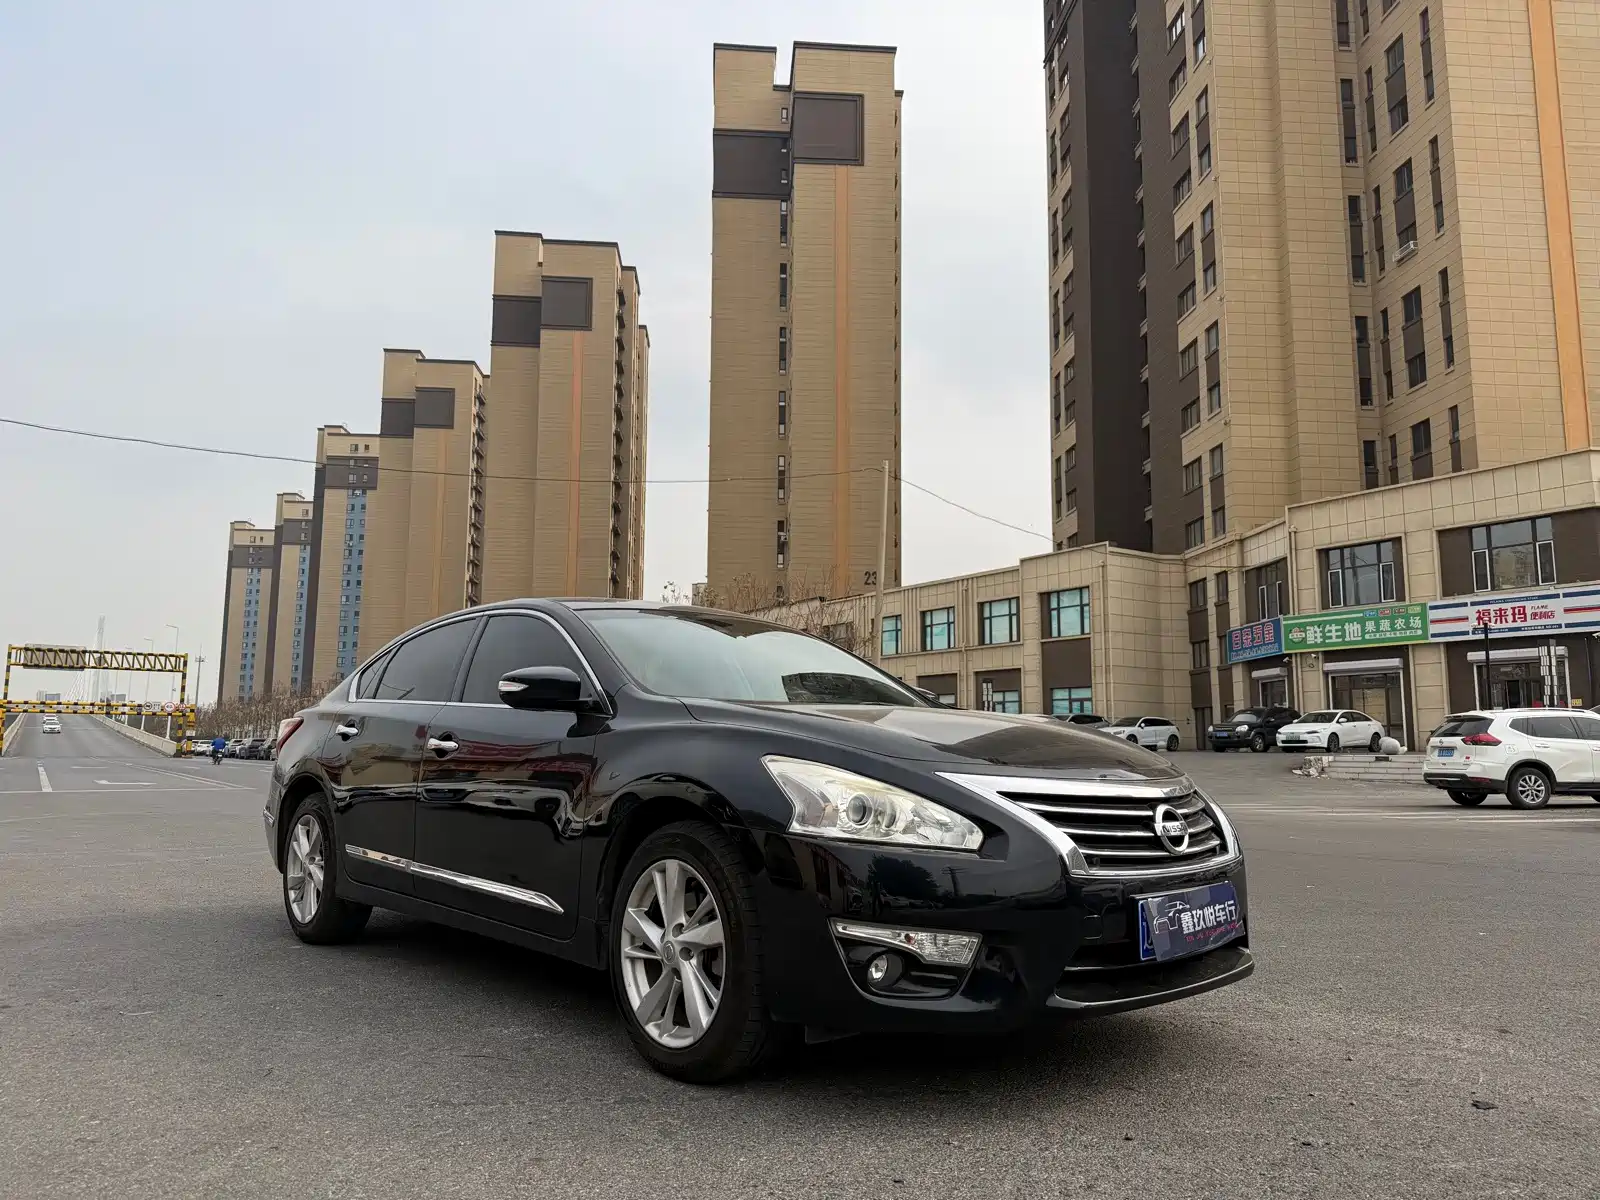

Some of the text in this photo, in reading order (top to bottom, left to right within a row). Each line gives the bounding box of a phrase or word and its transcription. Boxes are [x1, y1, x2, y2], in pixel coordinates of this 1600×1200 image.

[1365, 616, 1422, 633] 果蔬农场
[1475, 605, 1527, 626] 福来玛
[1530, 610, 1556, 621] 便利店
[1306, 622, 1362, 645] 鲜生地
[1180, 901, 1235, 934] 鑫玖悦车行
